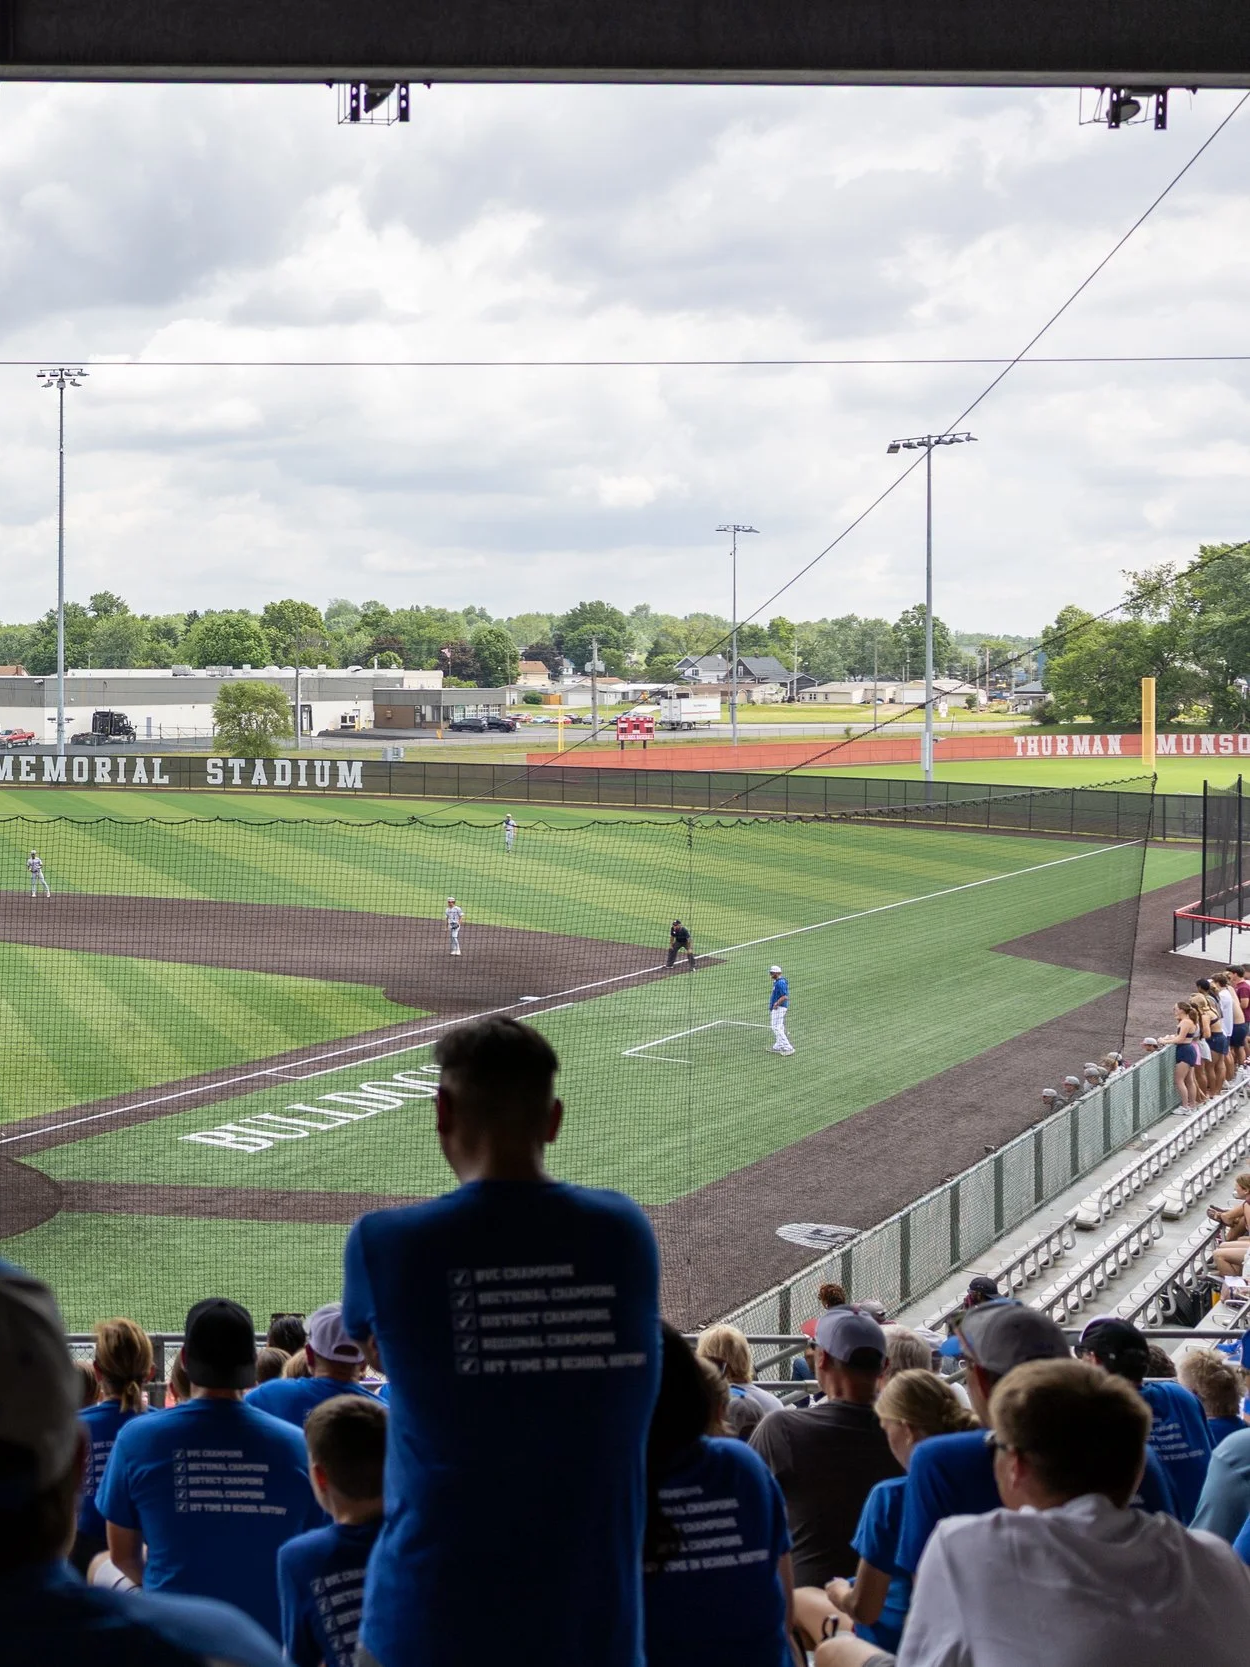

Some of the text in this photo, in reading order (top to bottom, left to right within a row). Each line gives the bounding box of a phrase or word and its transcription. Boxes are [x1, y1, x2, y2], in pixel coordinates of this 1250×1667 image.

[1014, 734, 1122, 756] THURMAN
[206, 758, 363, 788] STADIUM
[502, 1264, 574, 1282] CHAMPIONS
[550, 1284, 617, 1300] CHAMPIONS
[479, 1308, 611, 1328] DISTRICT CHAMPIONS
[481, 1331, 616, 1350] REGIONAL CHAMPIONS
[510, 1358, 542, 1374] TIME
[560, 1354, 607, 1370] SCHOOL
[202, 1450, 243, 1458] CHAMPIONS
[188, 1463, 269, 1472] SECTIONAL CHAMPIONS
[223, 1477, 264, 1485] CHAMPIONS
[189, 1490, 266, 1499] REGIONAL CHAMPIONS
[203, 1503, 222, 1512] TIME
[222, 1504, 232, 1512] IN
[232, 1504, 259, 1513] SCHOOL
[260, 1504, 287, 1515] HISTORY
[685, 1498, 739, 1514] CHAMPIONS
[681, 1516, 737, 1533] CHAMPIONS
[687, 1534, 742, 1552] CHAMPIONS
[701, 1555, 738, 1570] SCHOOL
[738, 1548, 770, 1564] HISTORY
